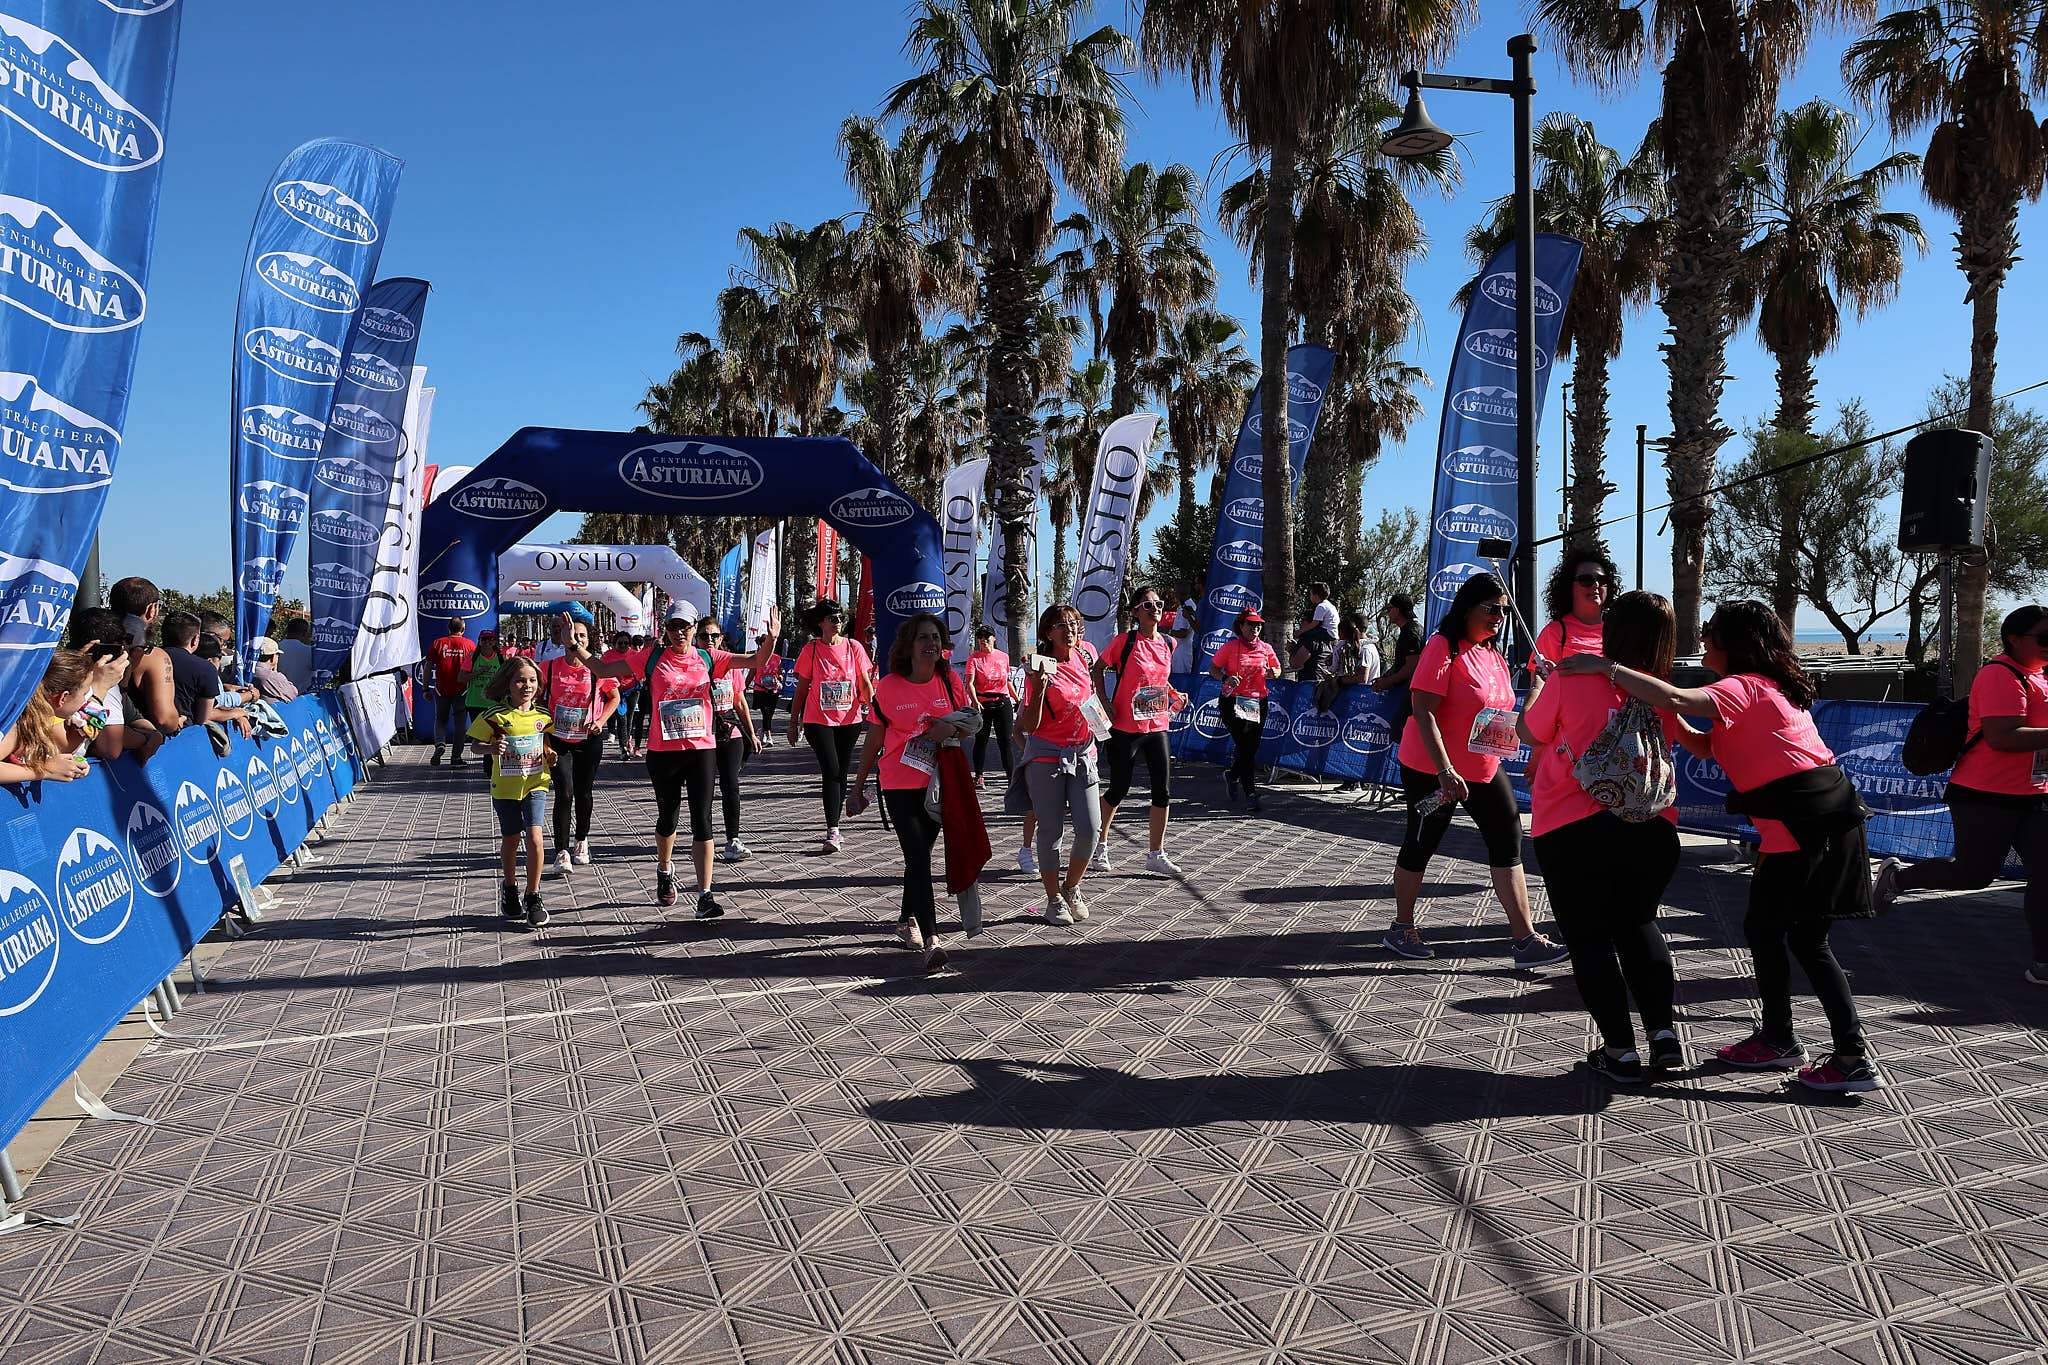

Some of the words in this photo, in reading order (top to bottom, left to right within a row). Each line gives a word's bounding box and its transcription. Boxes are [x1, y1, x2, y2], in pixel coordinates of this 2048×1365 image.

[71, 85, 136, 129] LECHERA
[281, 188, 369, 241] ASTURIANA
[57, 254, 120, 290] LECHERA
[252, 335, 338, 378] ASTURIAN
[346, 365, 399, 389] STURIANA
[1457, 396, 1517, 418] ASTURIA
[630, 457, 754, 486] ASTURIANA
[653, 456, 698, 465] CENTRAL
[703, 459, 749, 467] LECHERA
[317, 464, 382, 491] ASTURIANA
[456, 492, 539, 510] ASTURIANA
[838, 503, 910, 518] ASTURIANA
[311, 517, 374, 542] ASTURIANA
[1075, 445, 1139, 622] OYSHO
[1441, 520, 1511, 537] ASTURIANA
[536, 552, 636, 572] OYSHO
[823, 523, 833, 587] Santander
[947, 495, 974, 636] OYSHO
[311, 577, 367, 593] STURIANA
[418, 594, 486, 610] ASTURIANA
[1295, 720, 1335, 738] ASTURIANA
[1344, 724, 1390, 745] ASTURIANA
[1854, 764, 1902, 774] CENTRAL
[180, 814, 219, 850] ASTURIANA
[70, 867, 96, 887] CENTRAL
[95, 854, 119, 873] LECHERA
[132, 837, 178, 882] ASTURIANA
[10, 897, 41, 925] LECHERA
[63, 868, 131, 928] ASTURIANA
